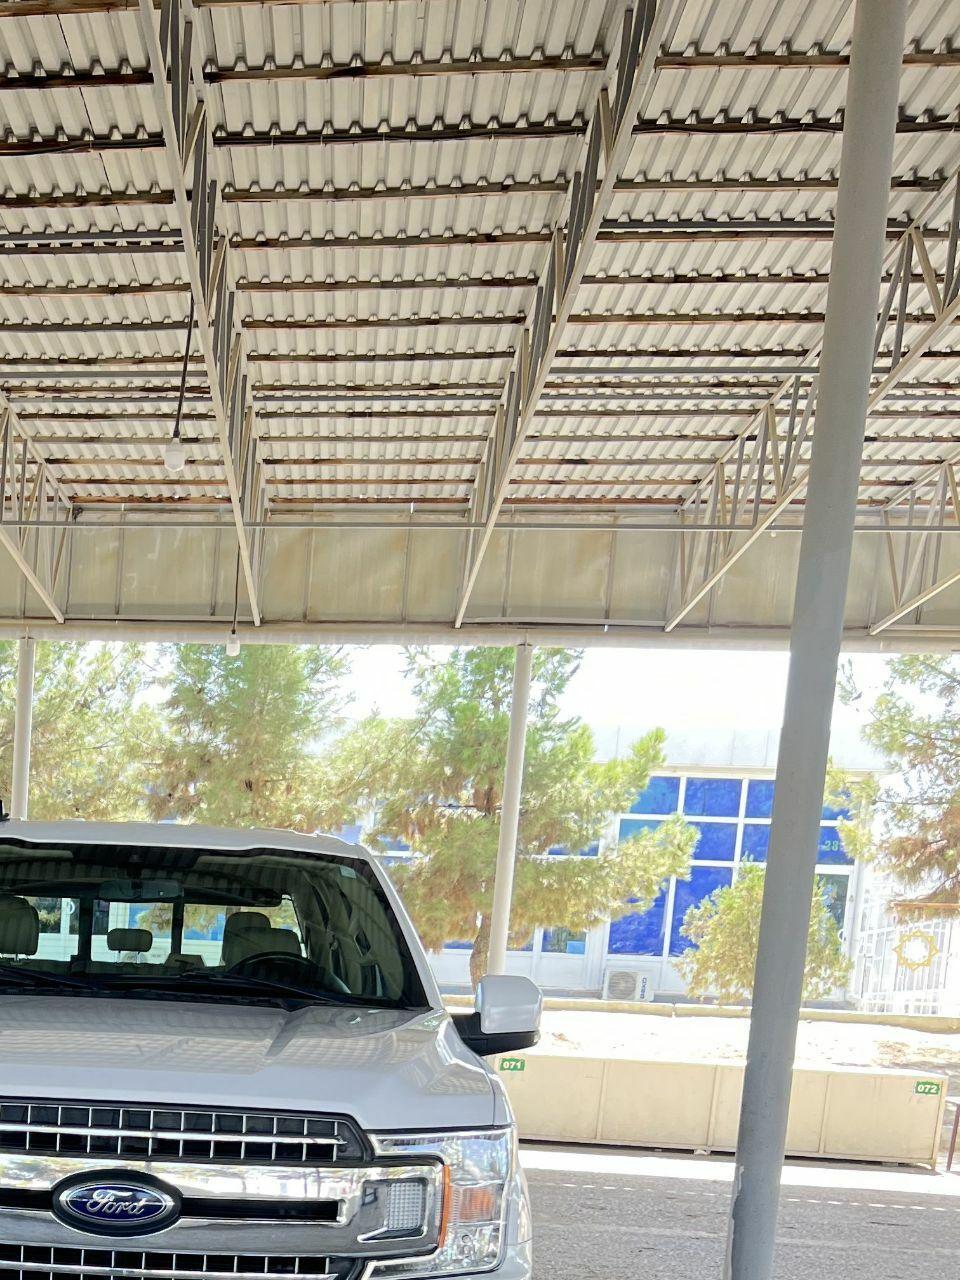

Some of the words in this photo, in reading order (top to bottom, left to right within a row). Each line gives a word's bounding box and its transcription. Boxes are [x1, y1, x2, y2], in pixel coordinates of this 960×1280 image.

[503, 1061, 522, 1069] 071
[917, 1084, 938, 1094] 072
[86, 1188, 148, 1215] Ford
